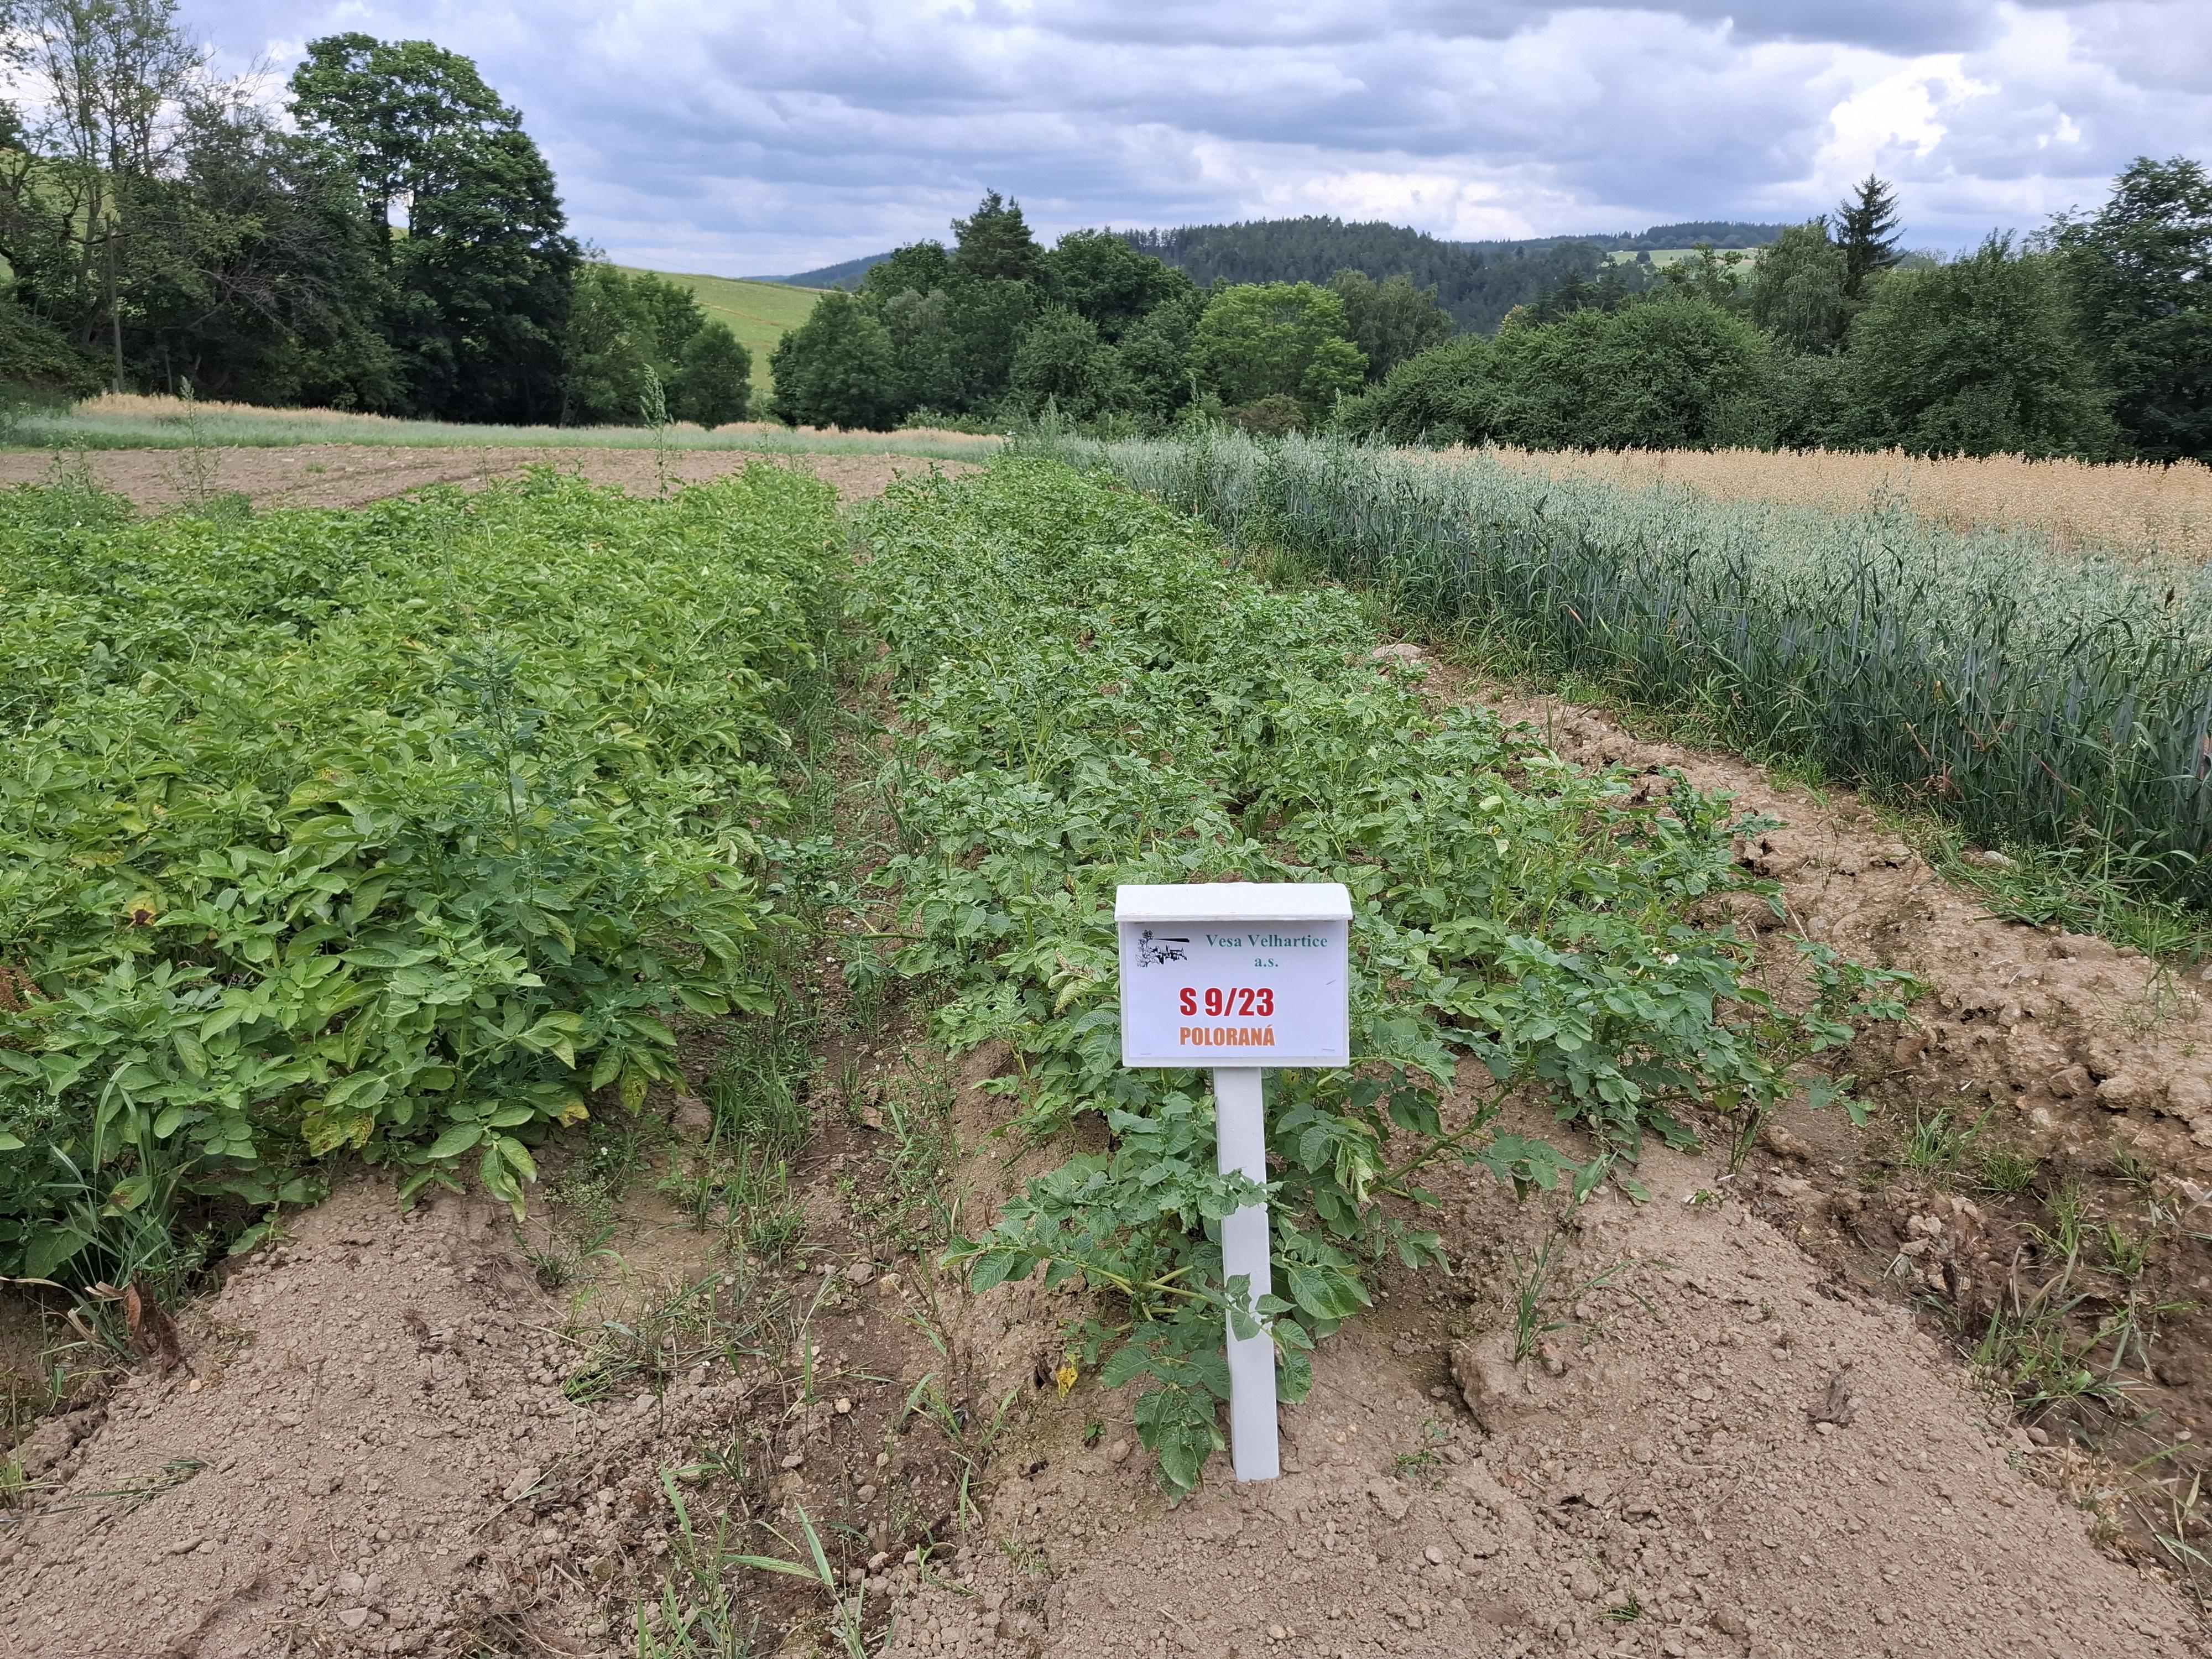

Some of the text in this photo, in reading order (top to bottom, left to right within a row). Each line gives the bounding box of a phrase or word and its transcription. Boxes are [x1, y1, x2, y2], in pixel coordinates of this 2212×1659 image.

[1206, 934, 1328, 947] Vesa Velhartice
[1254, 957, 1279, 967] a.s.
[1180, 987, 1275, 1016] S 9/23
[1180, 1024, 1275, 1046] POLORANÁ
